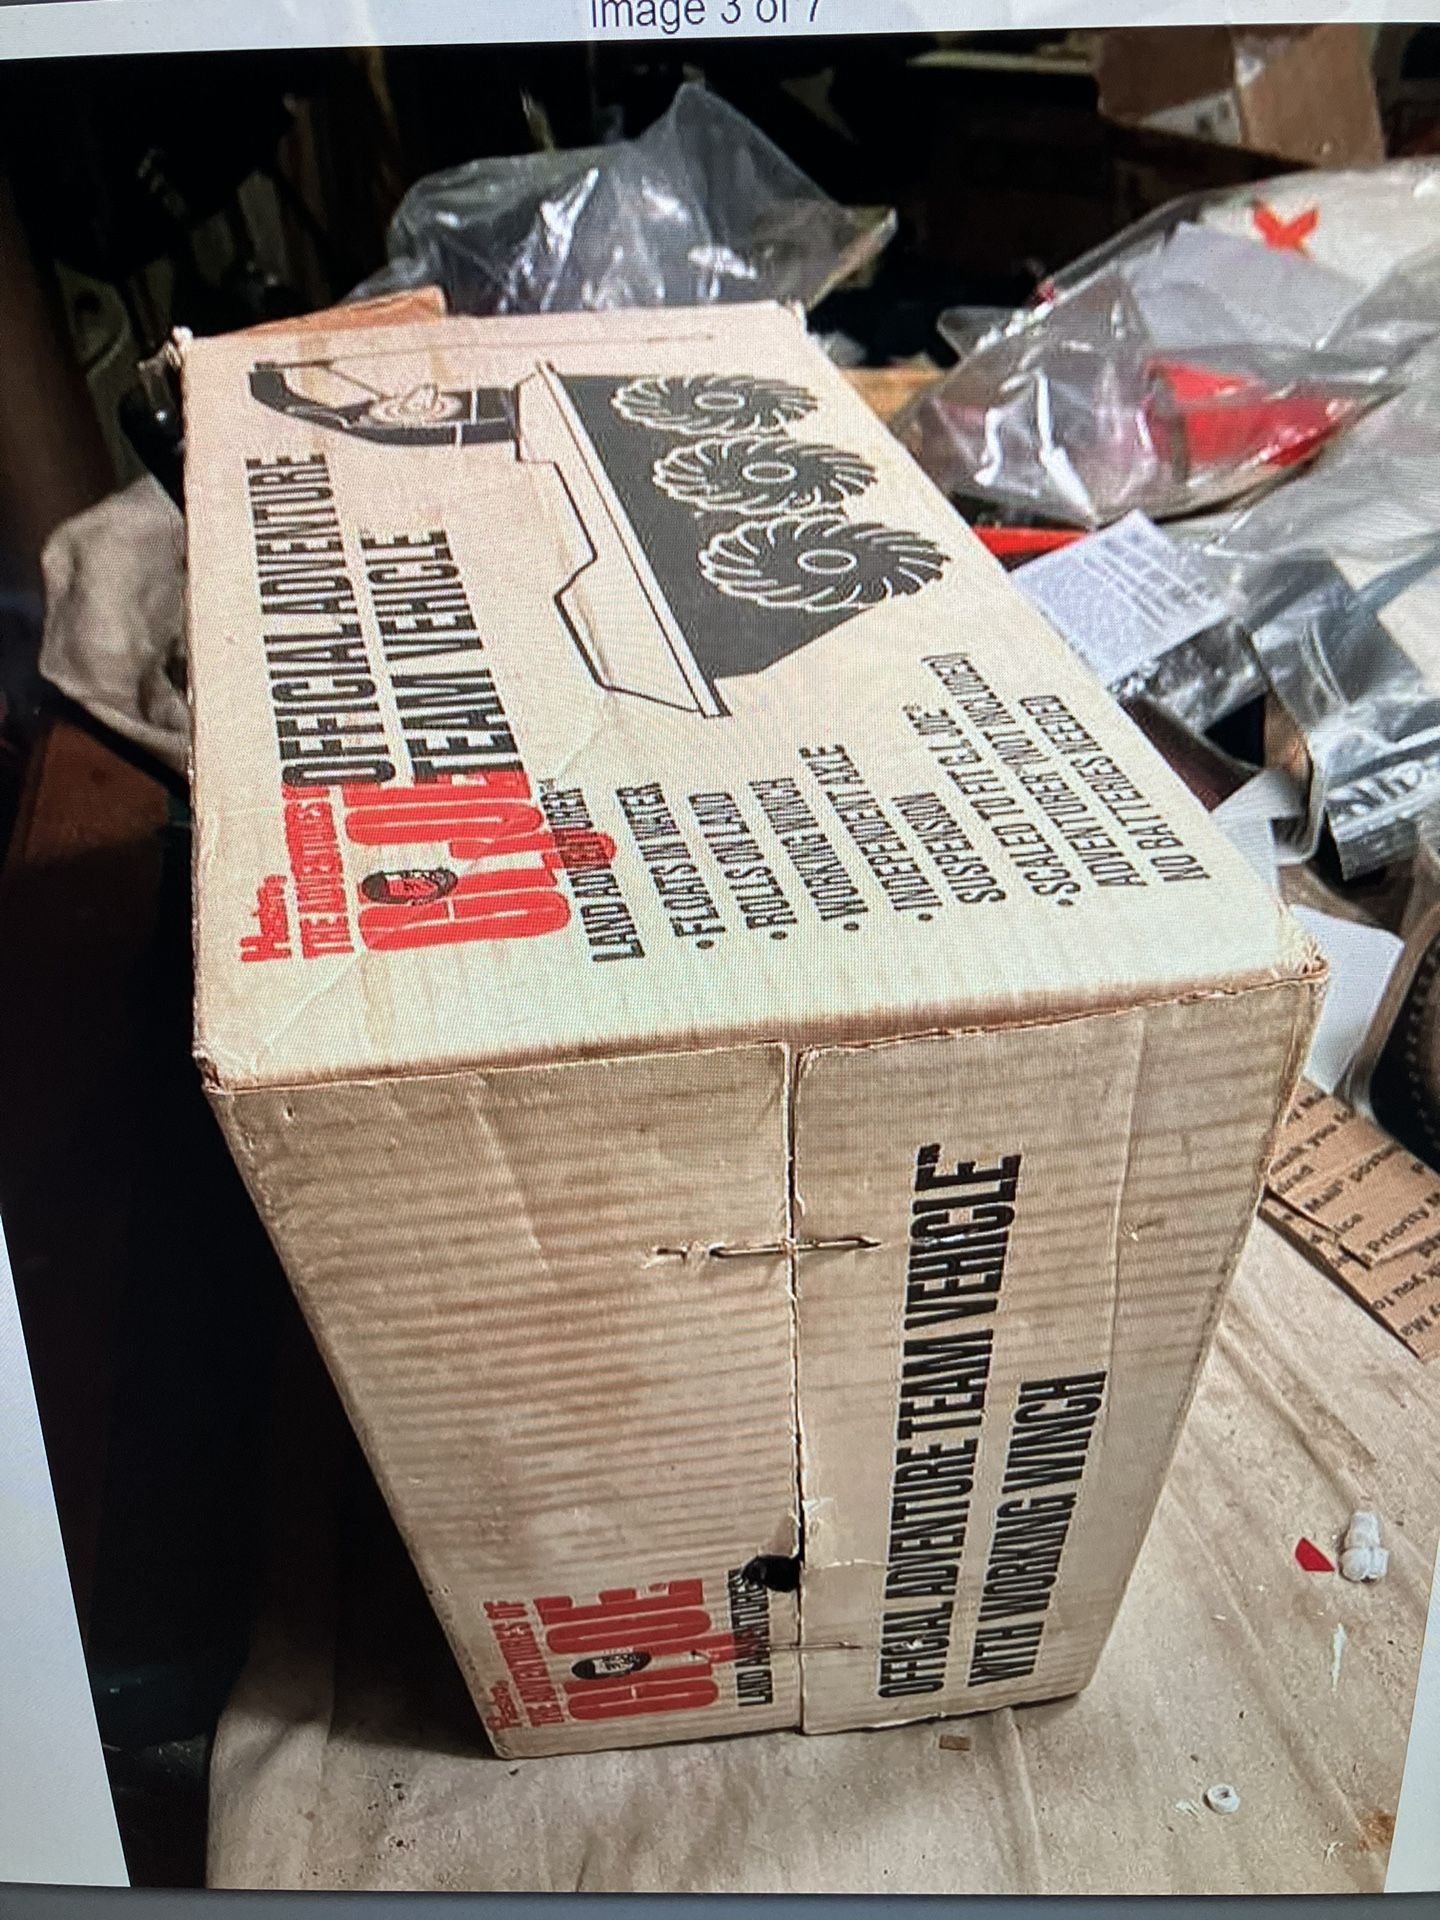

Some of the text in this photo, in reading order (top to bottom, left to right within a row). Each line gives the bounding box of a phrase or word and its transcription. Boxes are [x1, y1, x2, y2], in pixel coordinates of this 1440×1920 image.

[591, 0, 705, 35] Image
[246, 453, 396, 786] OFFICIAL ADVENTURE
[361, 530, 525, 784] TEAM VEHICLE
[921, 652, 1016, 726] INCLUDED)
[800, 744, 943, 912] INDEPENDENT AXLE
[947, 770, 1005, 795] FIT
[971, 797, 1024, 820] TO
[1018, 695, 1210, 882] NO BATTERIES NEEDED
[616, 782, 726, 937] FLOATS IN WATER
[688, 792, 798, 929] ROLLS ON LAND
[749, 778, 869, 921] WORKING WINCH
[891, 792, 1007, 904] SUSPENSION
[991, 823, 1081, 896] SCALED
[299, 914, 354, 958] THE
[580, 902, 645, 962] LAND
[897, 1328, 993, 1440] TEAM
[885, 1438, 979, 1600] ADVENTURE
[967, 1371, 1107, 1687] WITH WORKING WINCH
[483, 1600, 565, 1727] THE ADVENTURES OF
[736, 1669, 773, 1706] LAND
[878, 1600, 954, 1698] OFFICIAL
